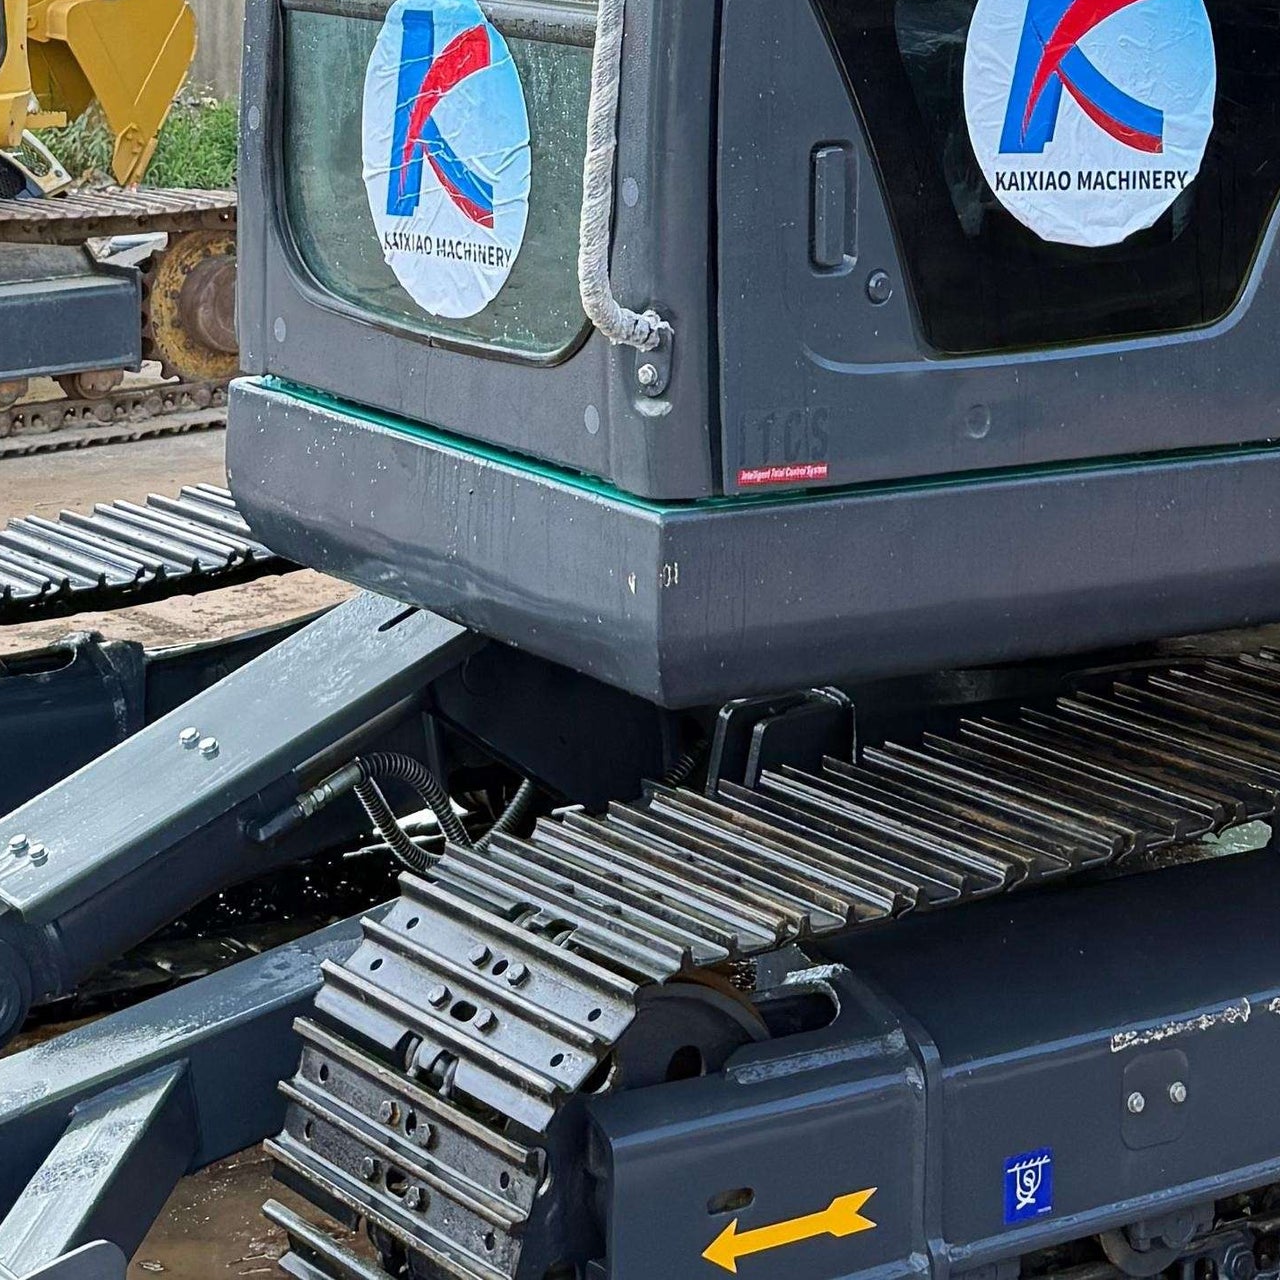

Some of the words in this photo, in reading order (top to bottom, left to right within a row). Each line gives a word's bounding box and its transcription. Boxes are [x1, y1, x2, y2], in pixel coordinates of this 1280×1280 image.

[995, 170, 1070, 191] KAIXIAO
[1077, 170, 1188, 190] MACHINERY
[384, 231, 433, 255] KAIXIAO
[436, 237, 512, 268] MACHINERY
